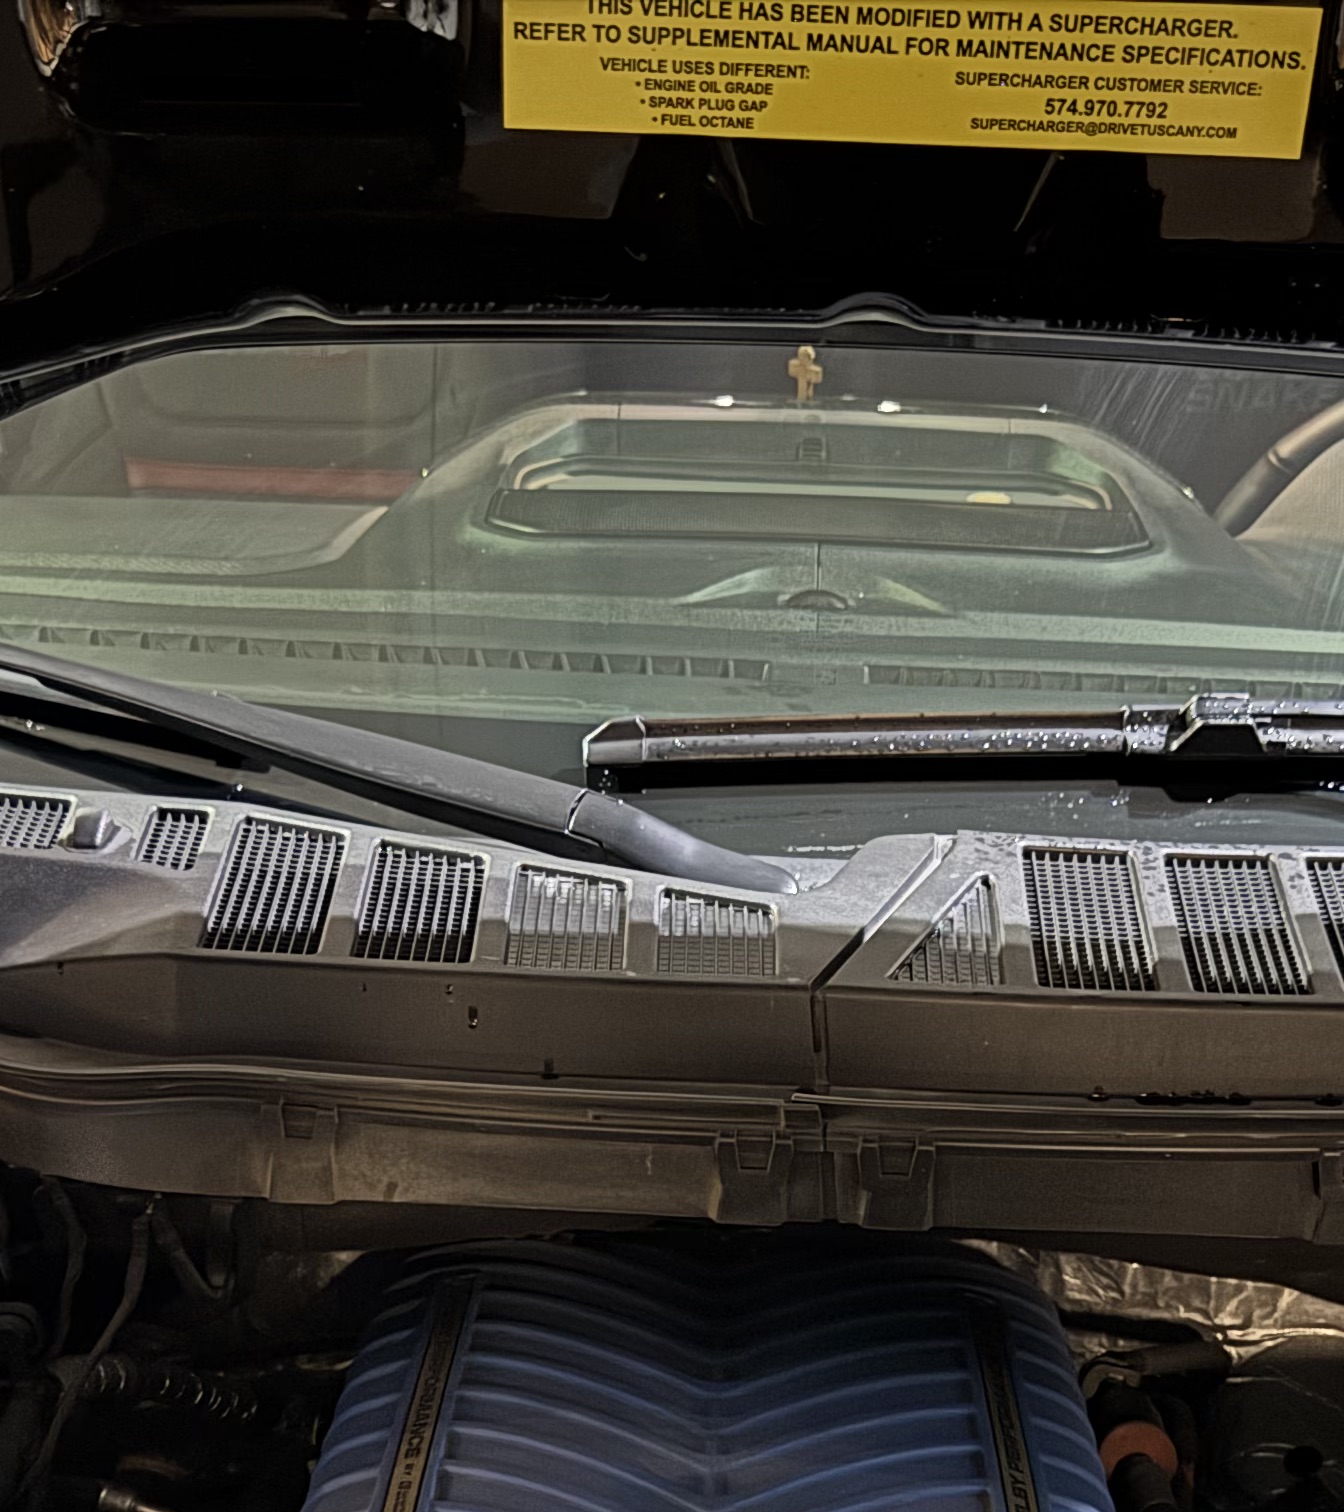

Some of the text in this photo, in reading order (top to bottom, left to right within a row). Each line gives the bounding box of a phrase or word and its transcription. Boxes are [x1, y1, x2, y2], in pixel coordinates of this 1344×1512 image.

[587, 0, 1238, 37] THIS VEHICLE HAS BEEN MODIFIED WITH A SUPERCHARGER.
[515, 22, 1306, 70] REFER TO SUPPLEMENTAL MANUAL FOR MAINTENANCE SPECIFICATIONS.
[601, 57, 810, 79] VEHICLE USES DIFFERENT:
[644, 78, 773, 95] ENGINE OIL GRADE
[956, 71, 1262, 96] SUPERCHARGER CUSTOMER SERVICE:
[649, 96, 768, 112] SPARK PLUG GAP
[1044, 98, 1168, 119] 574.970.7792
[661, 114, 754, 129] FUEL OCTANE
[970, 117, 1238, 139] SUPERCHARGER@DRIVETUSCANY.COM
